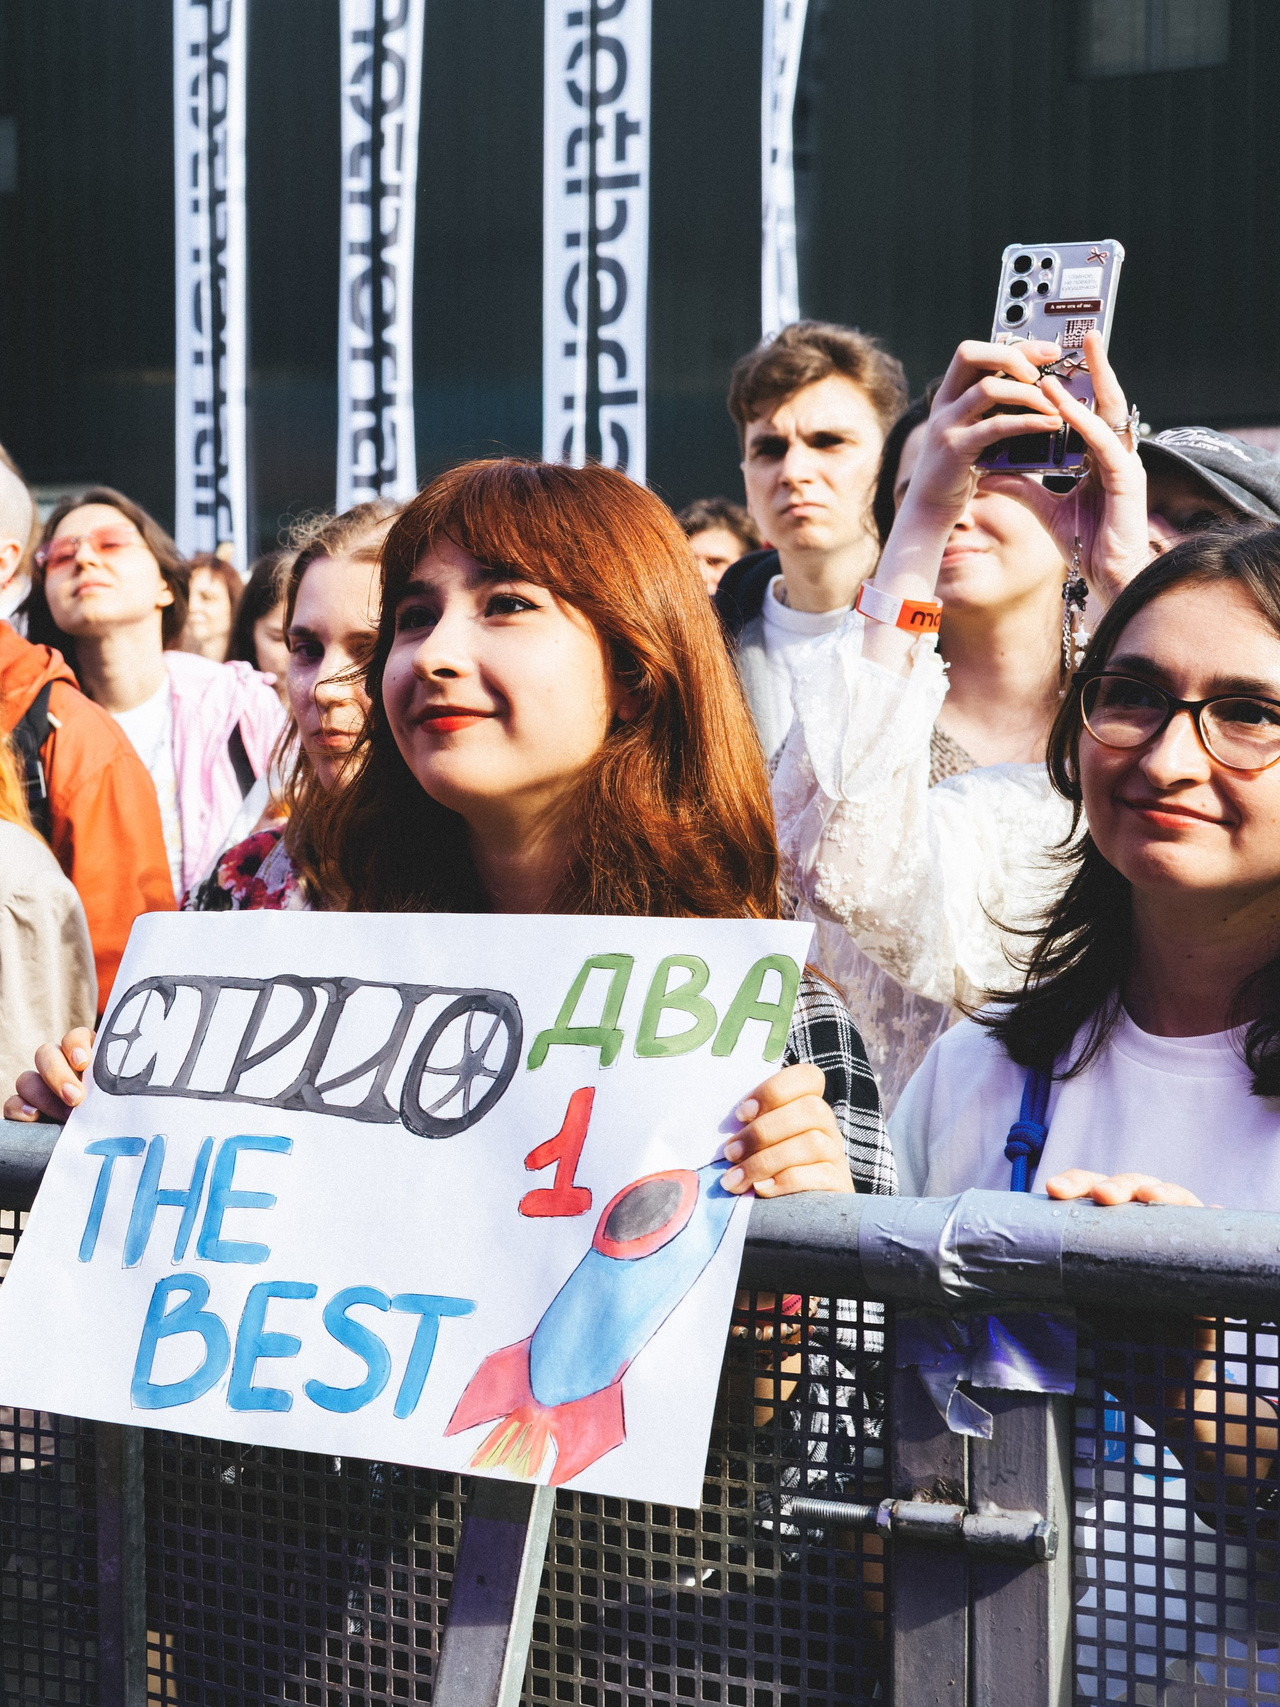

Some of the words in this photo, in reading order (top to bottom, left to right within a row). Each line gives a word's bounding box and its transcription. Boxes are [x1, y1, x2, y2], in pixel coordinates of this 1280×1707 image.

[526, 953, 799, 1070] ДВА
[77, 1133, 292, 1269] THE
[519, 1087, 596, 1218] 1
[130, 1273, 477, 1420] BEST
